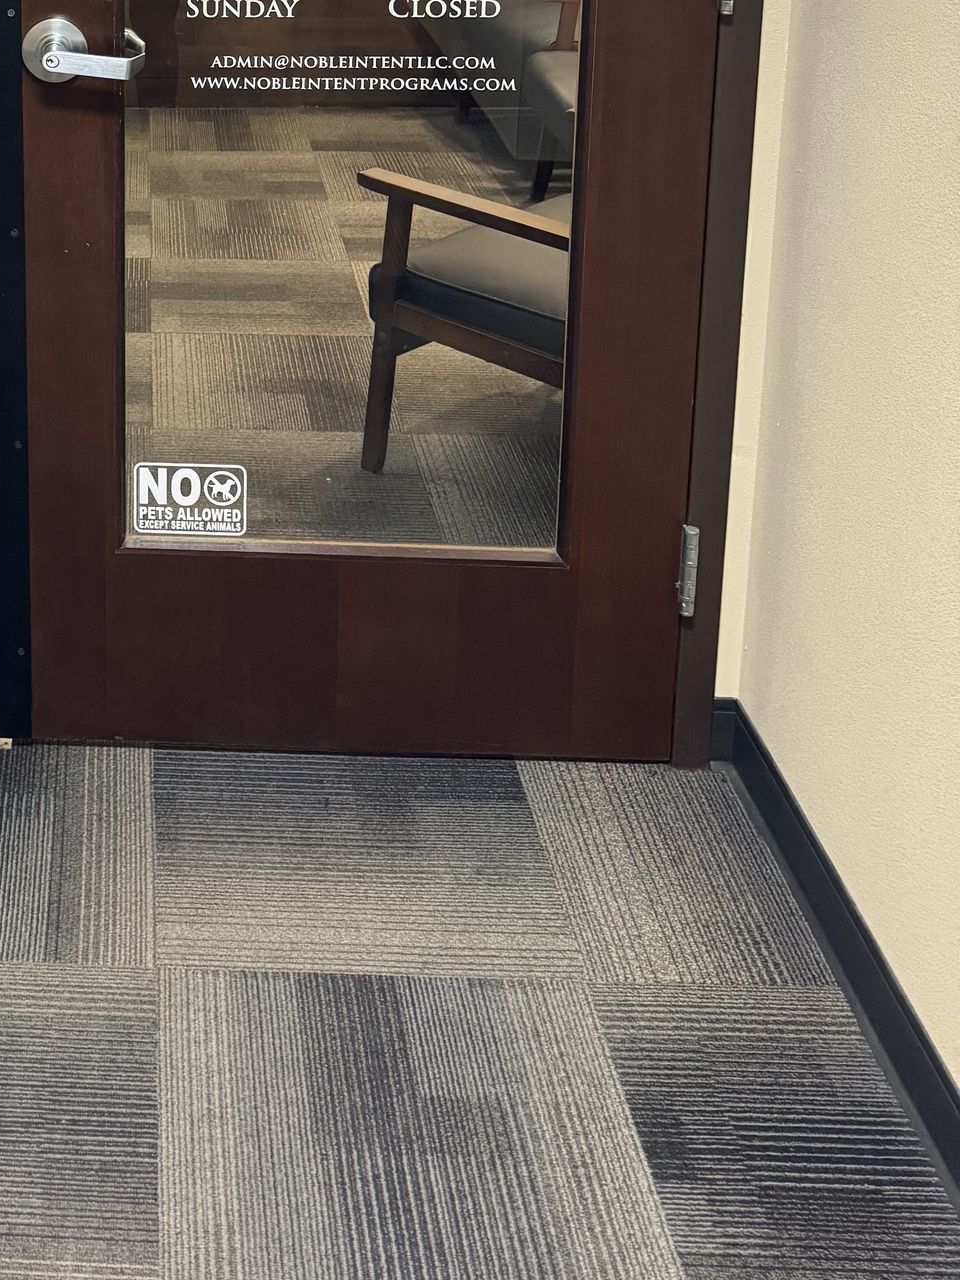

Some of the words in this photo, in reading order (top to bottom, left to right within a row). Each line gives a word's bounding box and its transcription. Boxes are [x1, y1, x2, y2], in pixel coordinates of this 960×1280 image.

[139, 467, 201, 506] NO
[139, 507, 173, 520] PETS
[177, 508, 241, 522] ALLOWED
[140, 520, 169, 529] EXCEPT
[171, 521, 204, 530] SERVICE
[206, 522, 241, 532] ANIMALS
